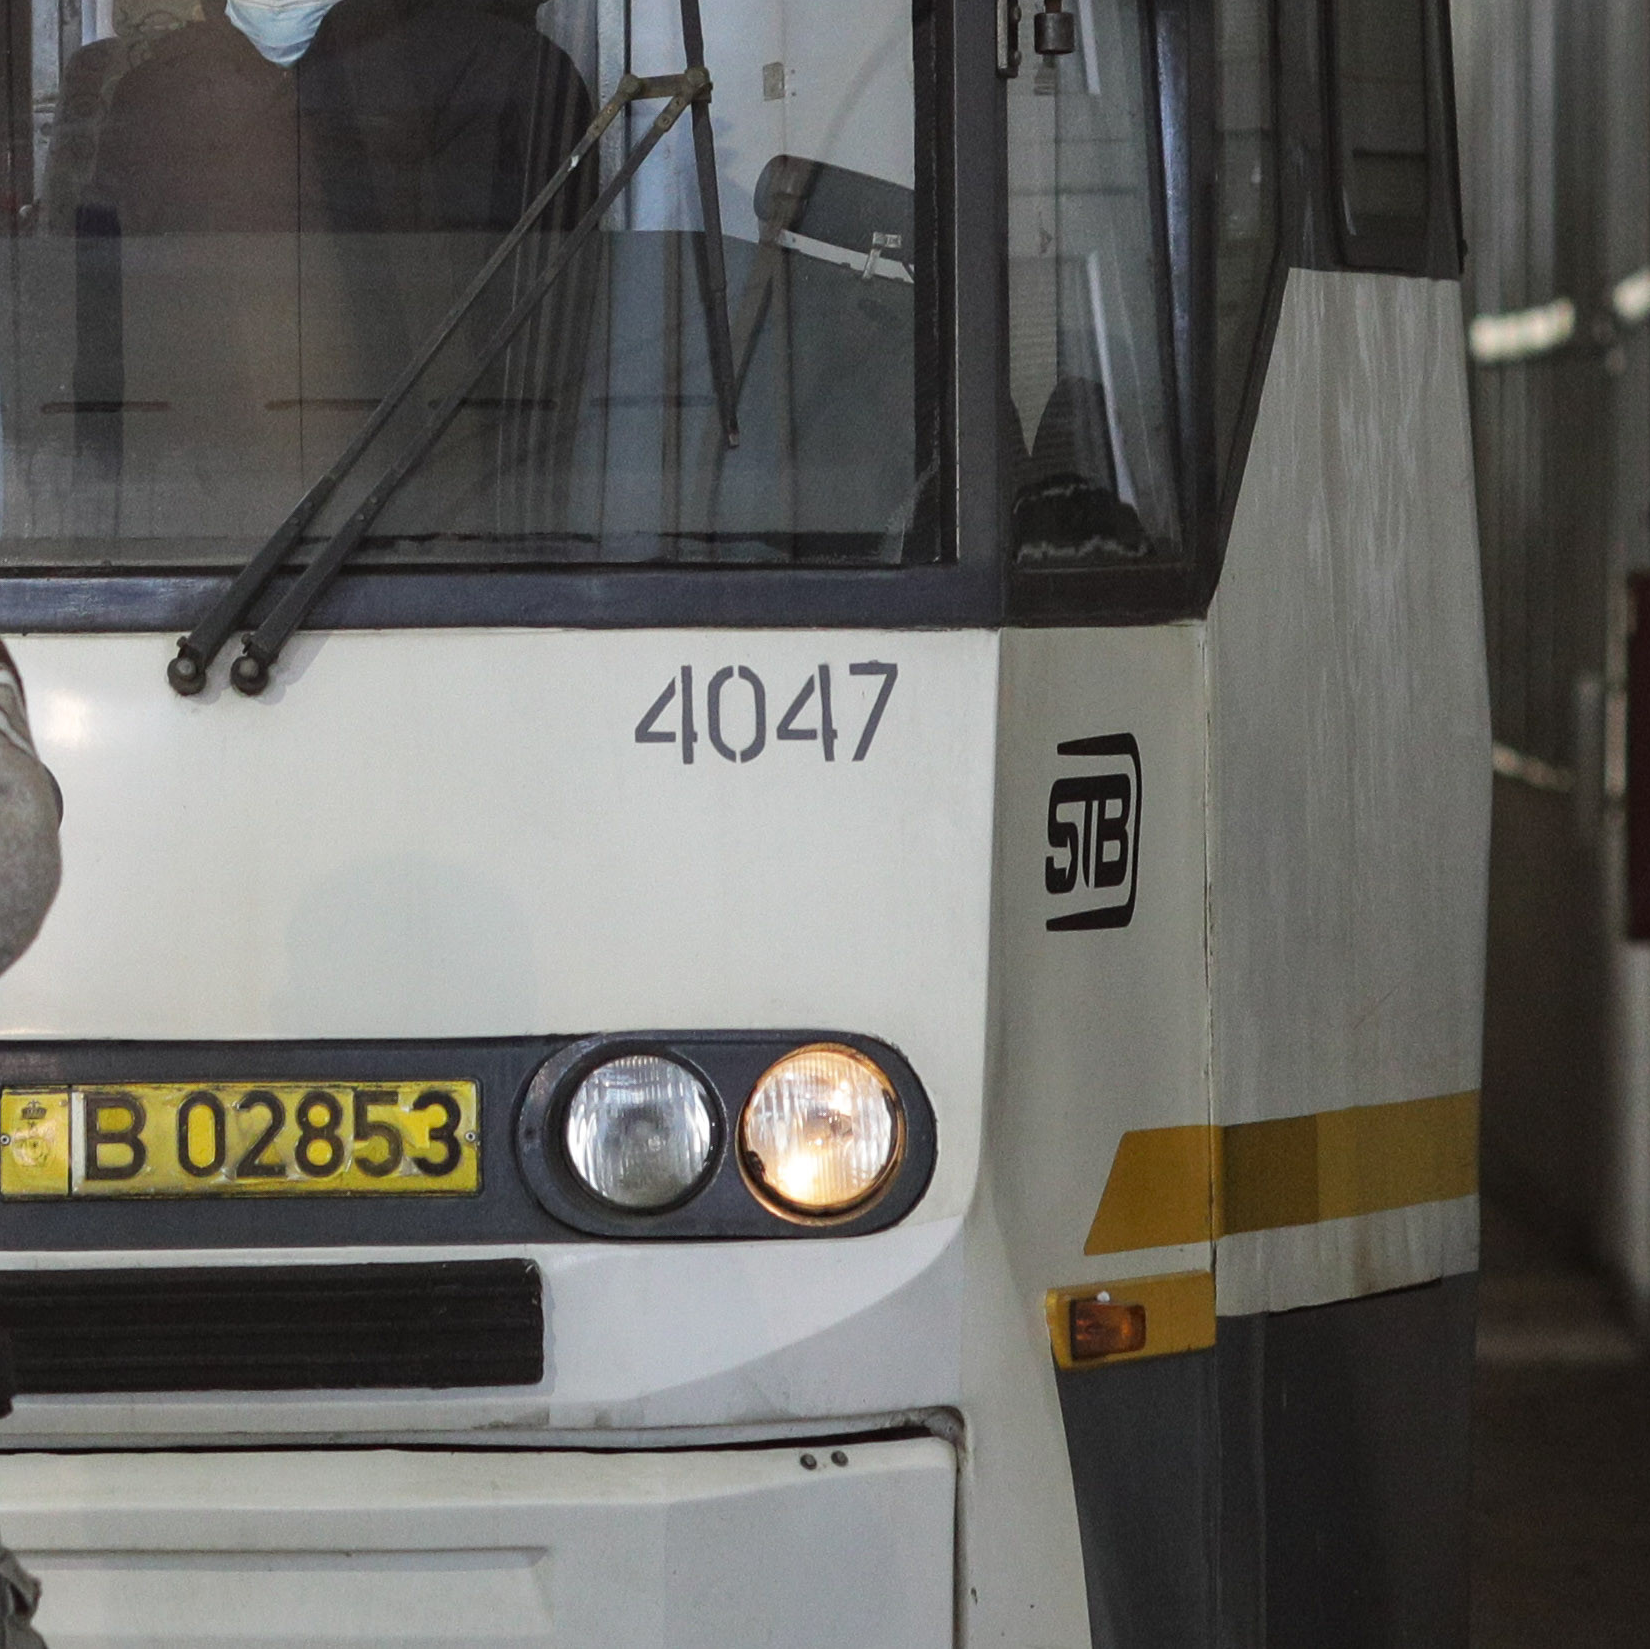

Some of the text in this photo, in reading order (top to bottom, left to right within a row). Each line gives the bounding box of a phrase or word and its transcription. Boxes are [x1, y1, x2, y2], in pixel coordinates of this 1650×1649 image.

[634, 659, 899, 765] 4047
[1045, 772, 1132, 895] STB
[84, 1088, 463, 1181] B 02853
